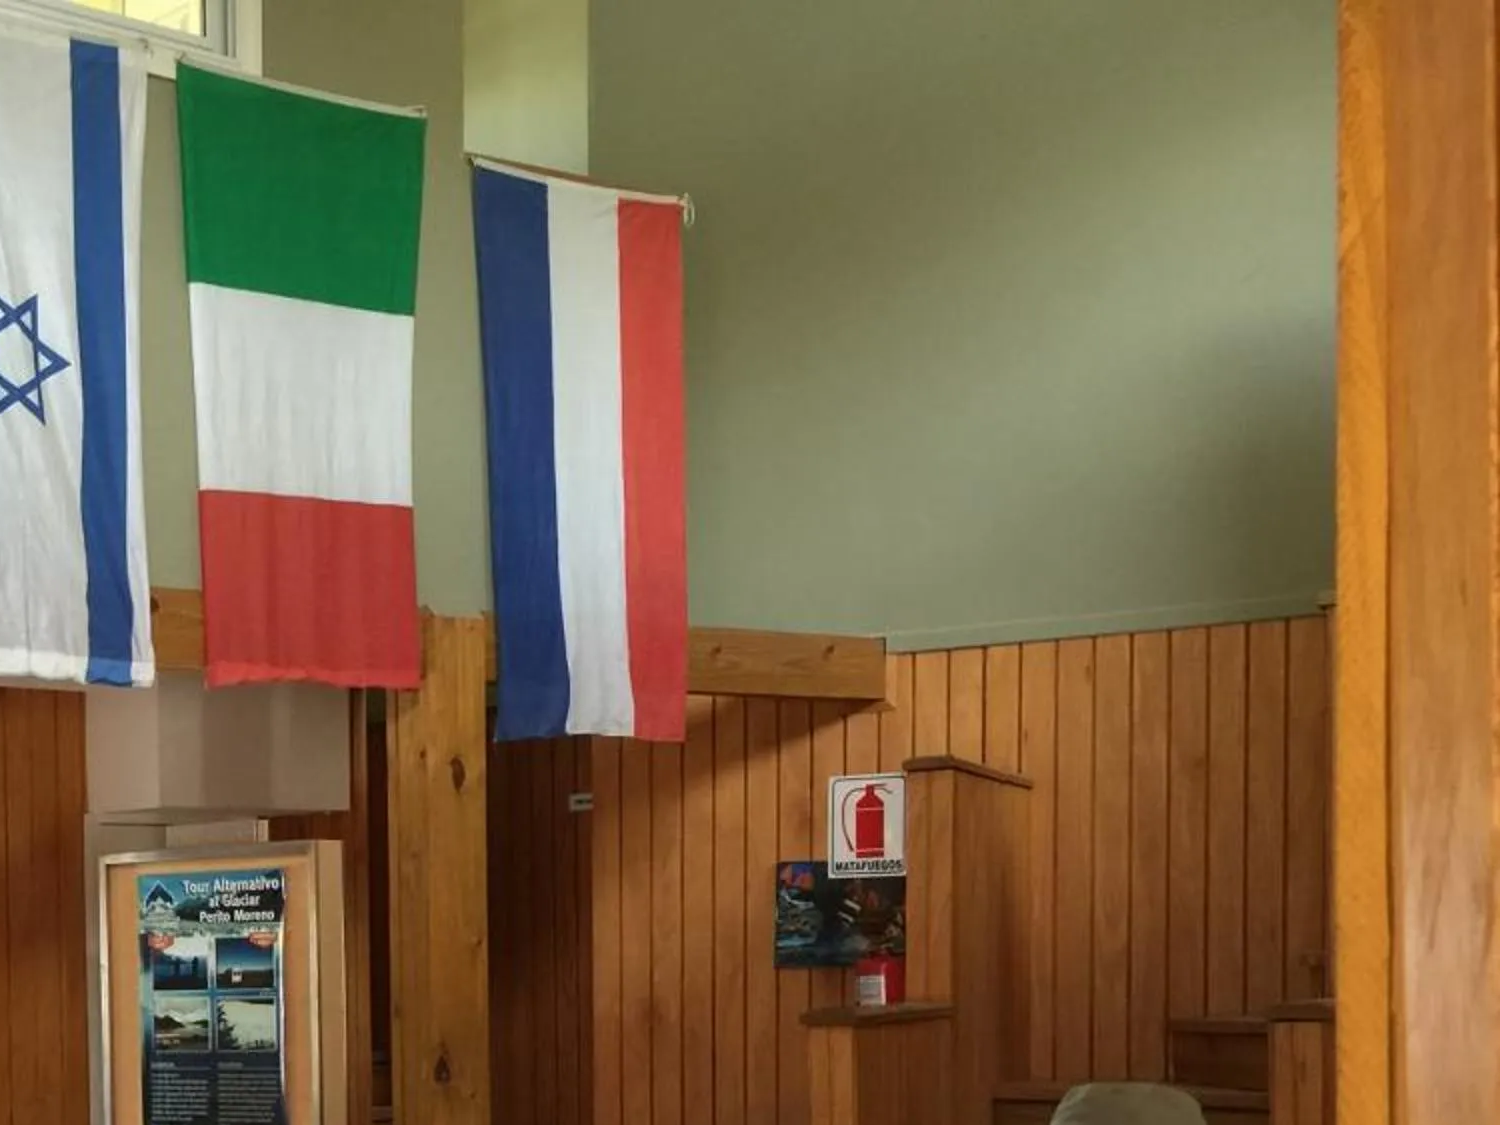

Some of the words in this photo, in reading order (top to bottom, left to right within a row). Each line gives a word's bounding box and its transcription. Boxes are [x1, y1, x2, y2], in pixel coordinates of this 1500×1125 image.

[835, 859, 904, 872] MATAFUEGOS
[182, 880, 210, 895] Tour
[213, 875, 279, 894] Alternativo
[221, 894, 260, 907] Glaciar
[199, 910, 231, 923] Perito
[233, 909, 275, 921] Moreno
